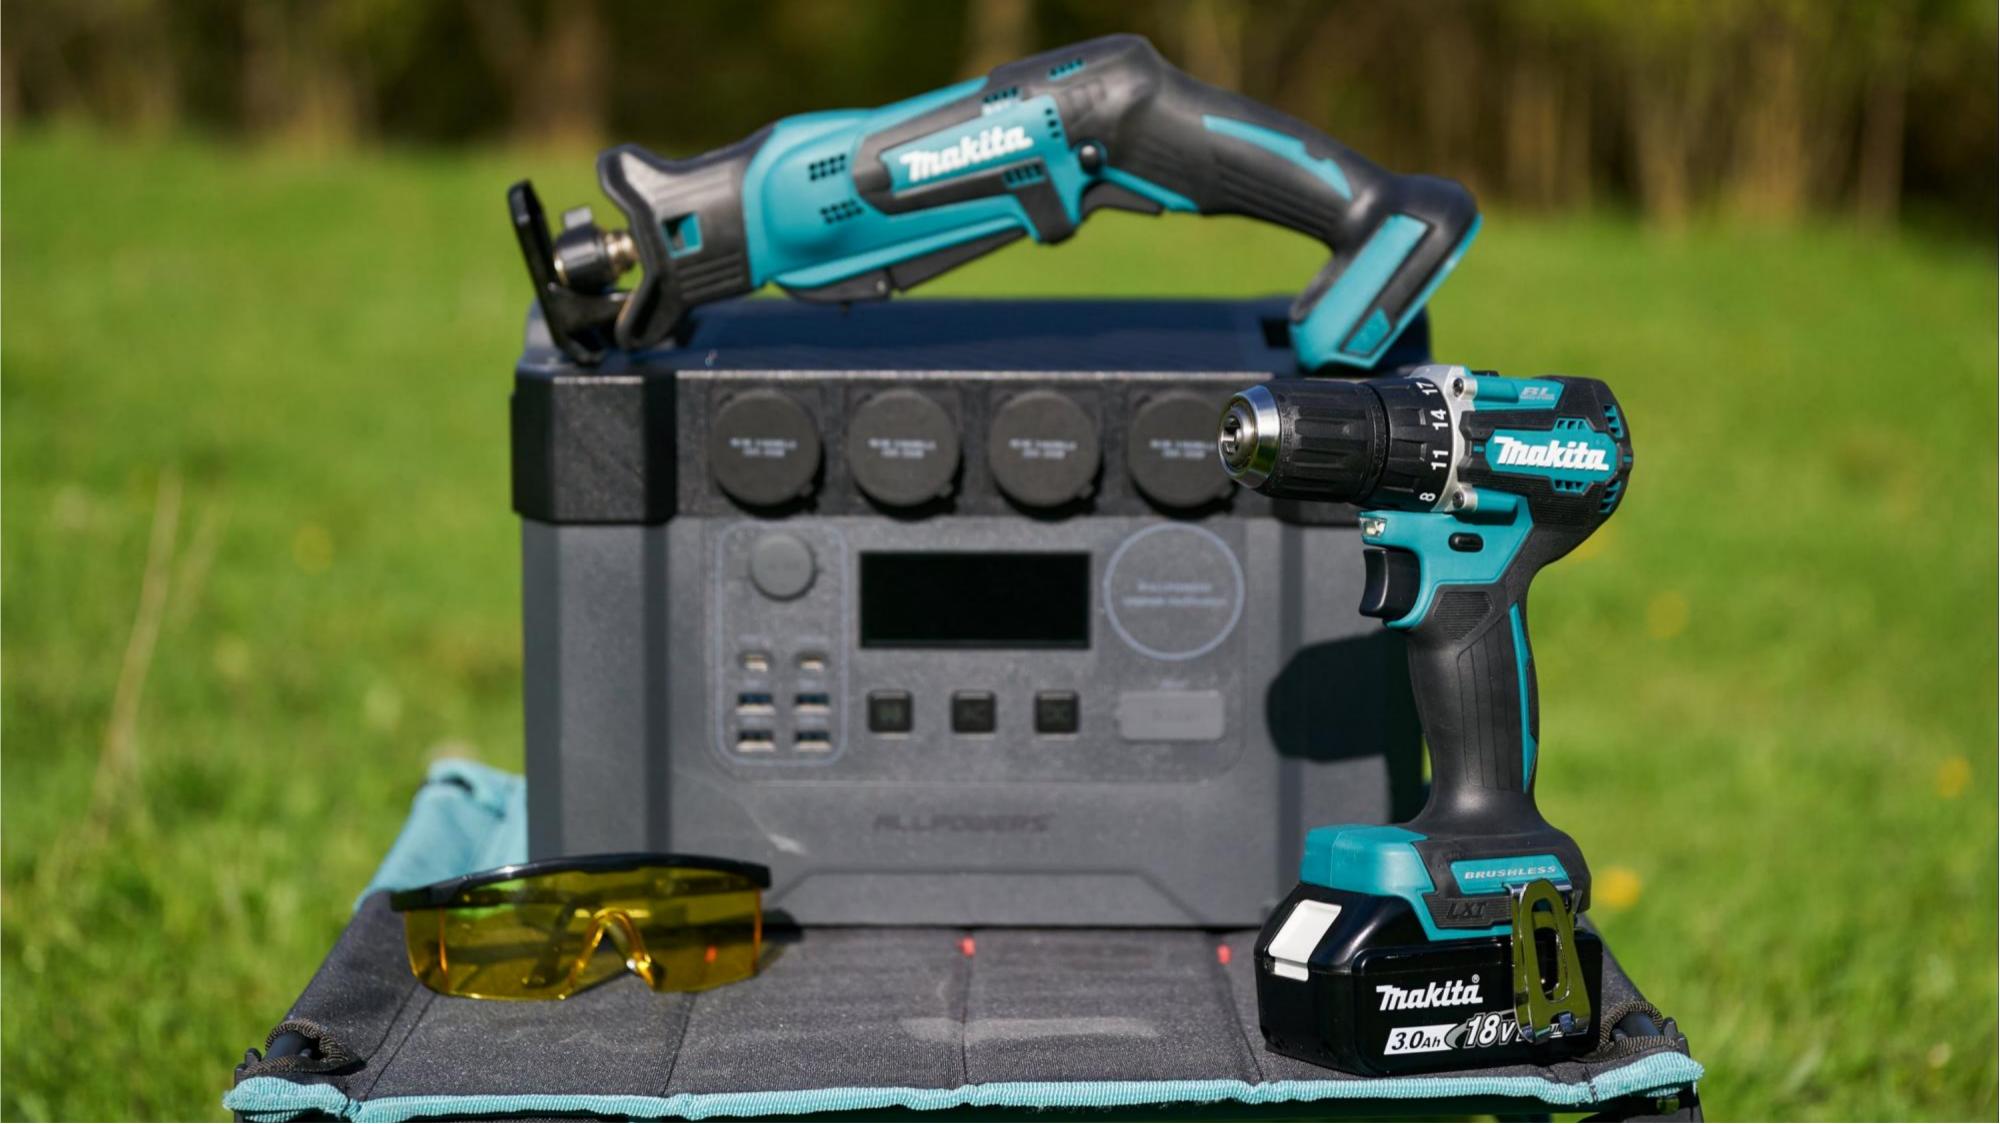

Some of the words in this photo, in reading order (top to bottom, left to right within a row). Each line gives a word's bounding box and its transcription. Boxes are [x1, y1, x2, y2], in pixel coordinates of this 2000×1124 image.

[1416, 381, 1438, 396] 17
[1430, 408, 1449, 431] 14
[1430, 449, 1449, 472] 11
[1419, 492, 1436, 502] 8
[1464, 865, 1557, 880] BRUSHLESS
